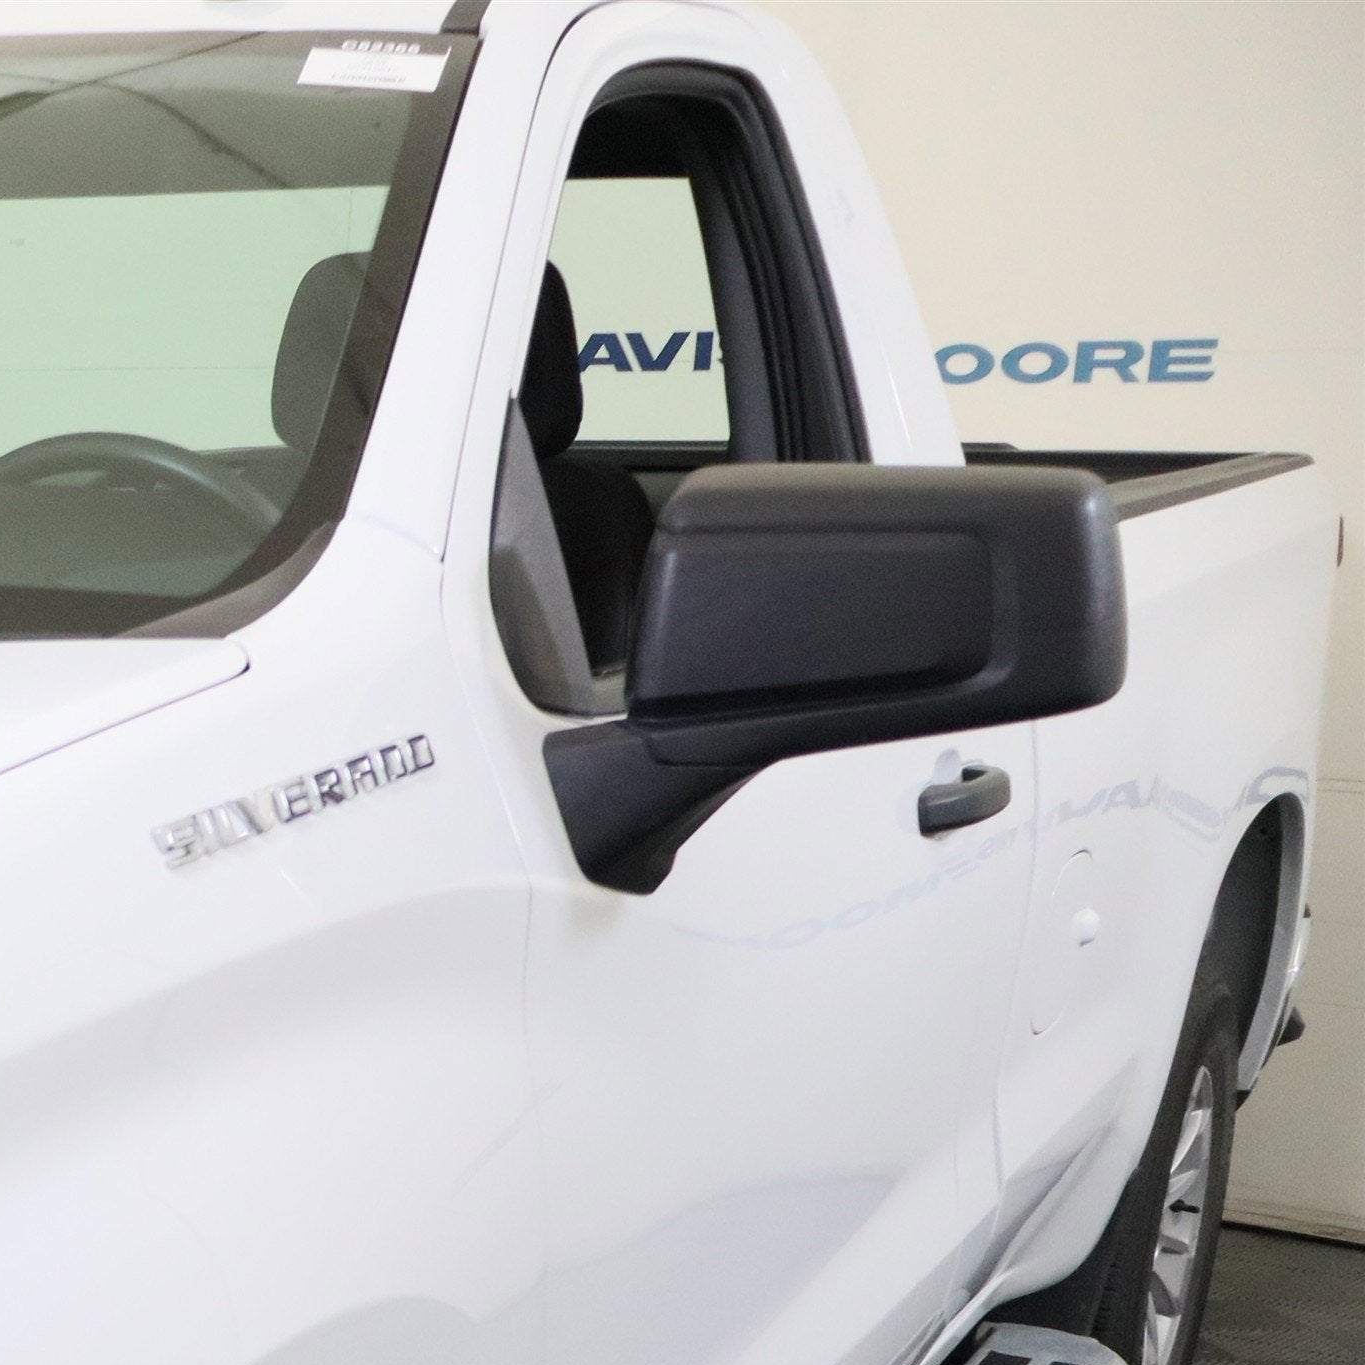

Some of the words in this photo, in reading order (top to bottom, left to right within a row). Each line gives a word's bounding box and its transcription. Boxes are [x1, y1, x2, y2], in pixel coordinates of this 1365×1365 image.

[577, 331, 723, 372] AVI
[934, 338, 1220, 385] OORE
[149, 733, 436, 870] SILVERADO
